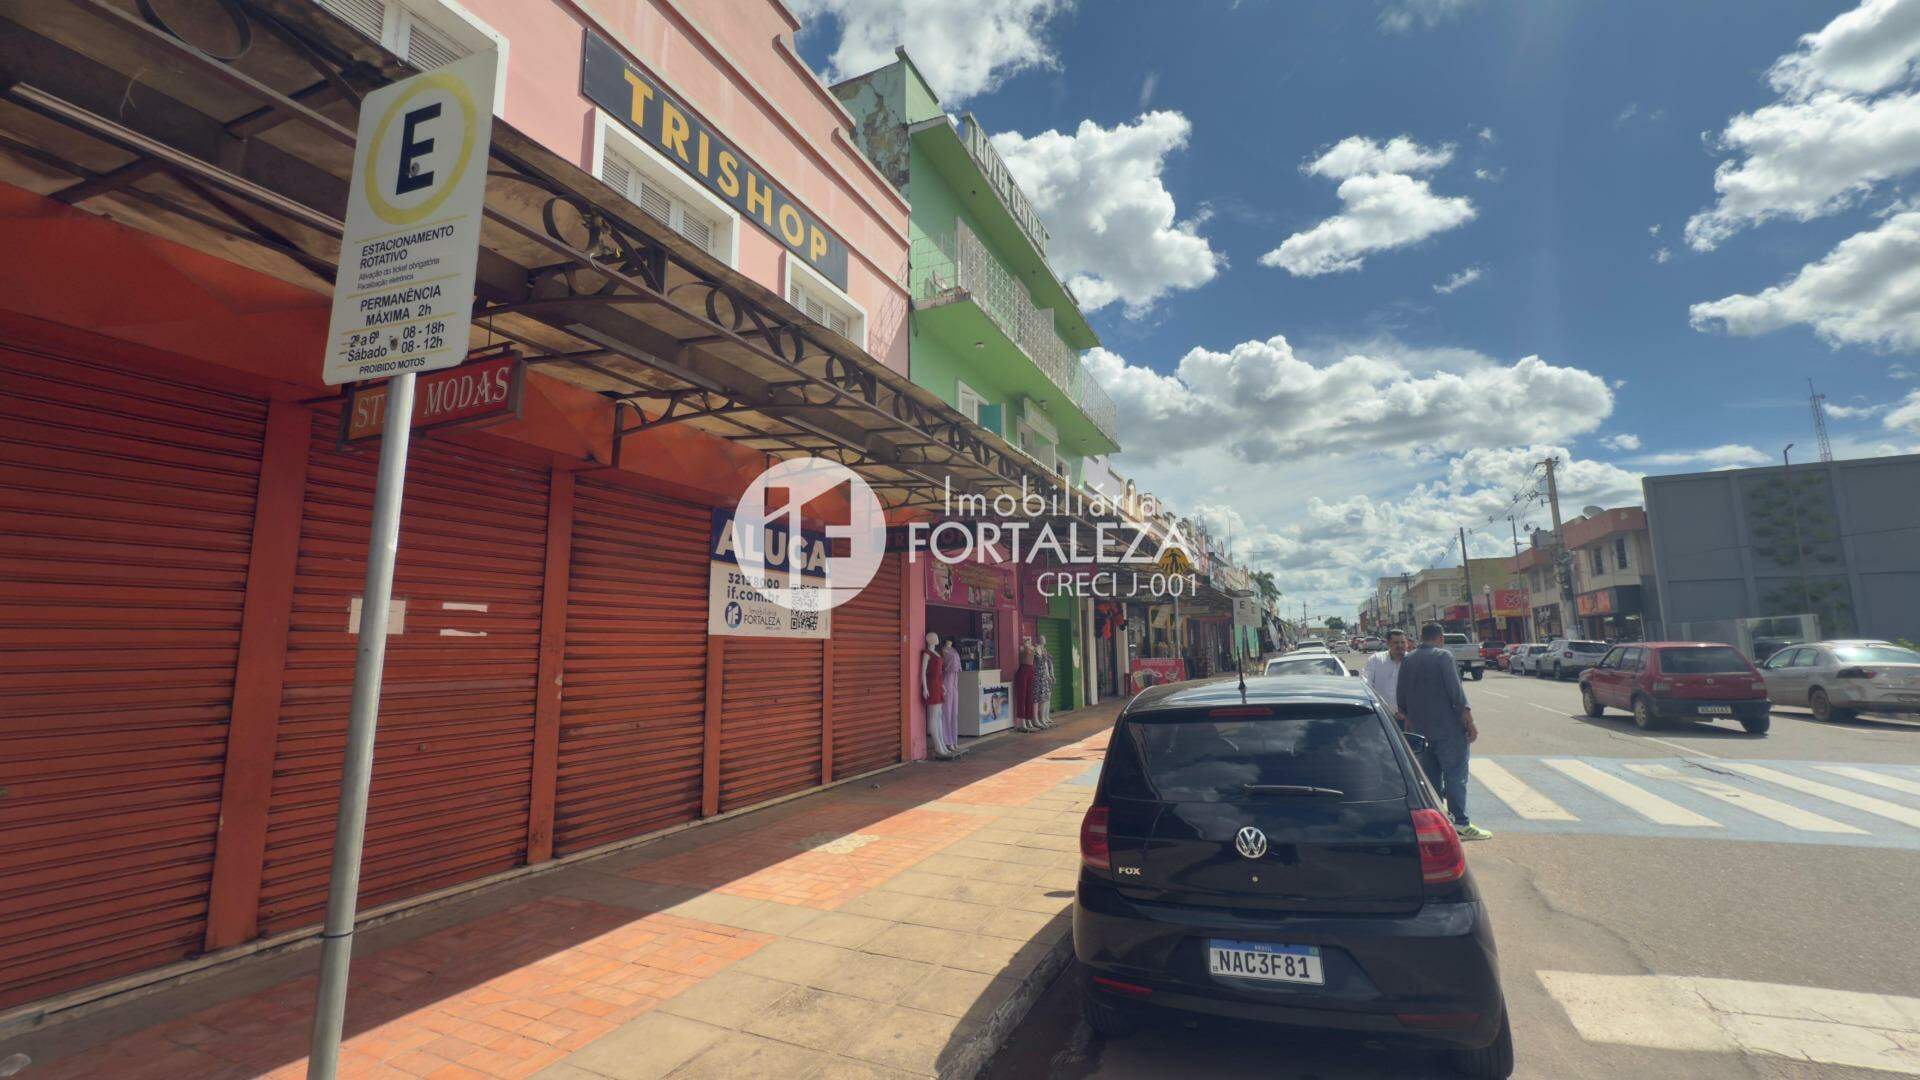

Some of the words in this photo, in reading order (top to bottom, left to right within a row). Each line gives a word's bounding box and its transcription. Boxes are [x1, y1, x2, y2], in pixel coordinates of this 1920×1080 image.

[395, 102, 442, 195] E
[624, 68, 827, 263] TRISHOP
[362, 225, 454, 257] ESTACIONAMENTO
[360, 249, 408, 269] ROTATIVO
[360, 285, 441, 312] PERMANÊNCIA
[366, 307, 410, 327] MÁXIMA
[417, 303, 431, 317] 2h
[402, 326, 416, 339] 08
[425, 322, 445, 336] 18h
[401, 340, 414, 354] 08
[423, 336, 443, 350] 12h
[359, 362, 397, 375] PROIBIDO
[397, 357, 425, 370] MOTOS
[423, 366, 512, 417] MODAS
[715, 519, 828, 573] ALUGA
[743, 614, 782, 626] FORTALEZA
[1118, 866, 1141, 876] FOX
[1219, 950, 1310, 979] NAC3F81
